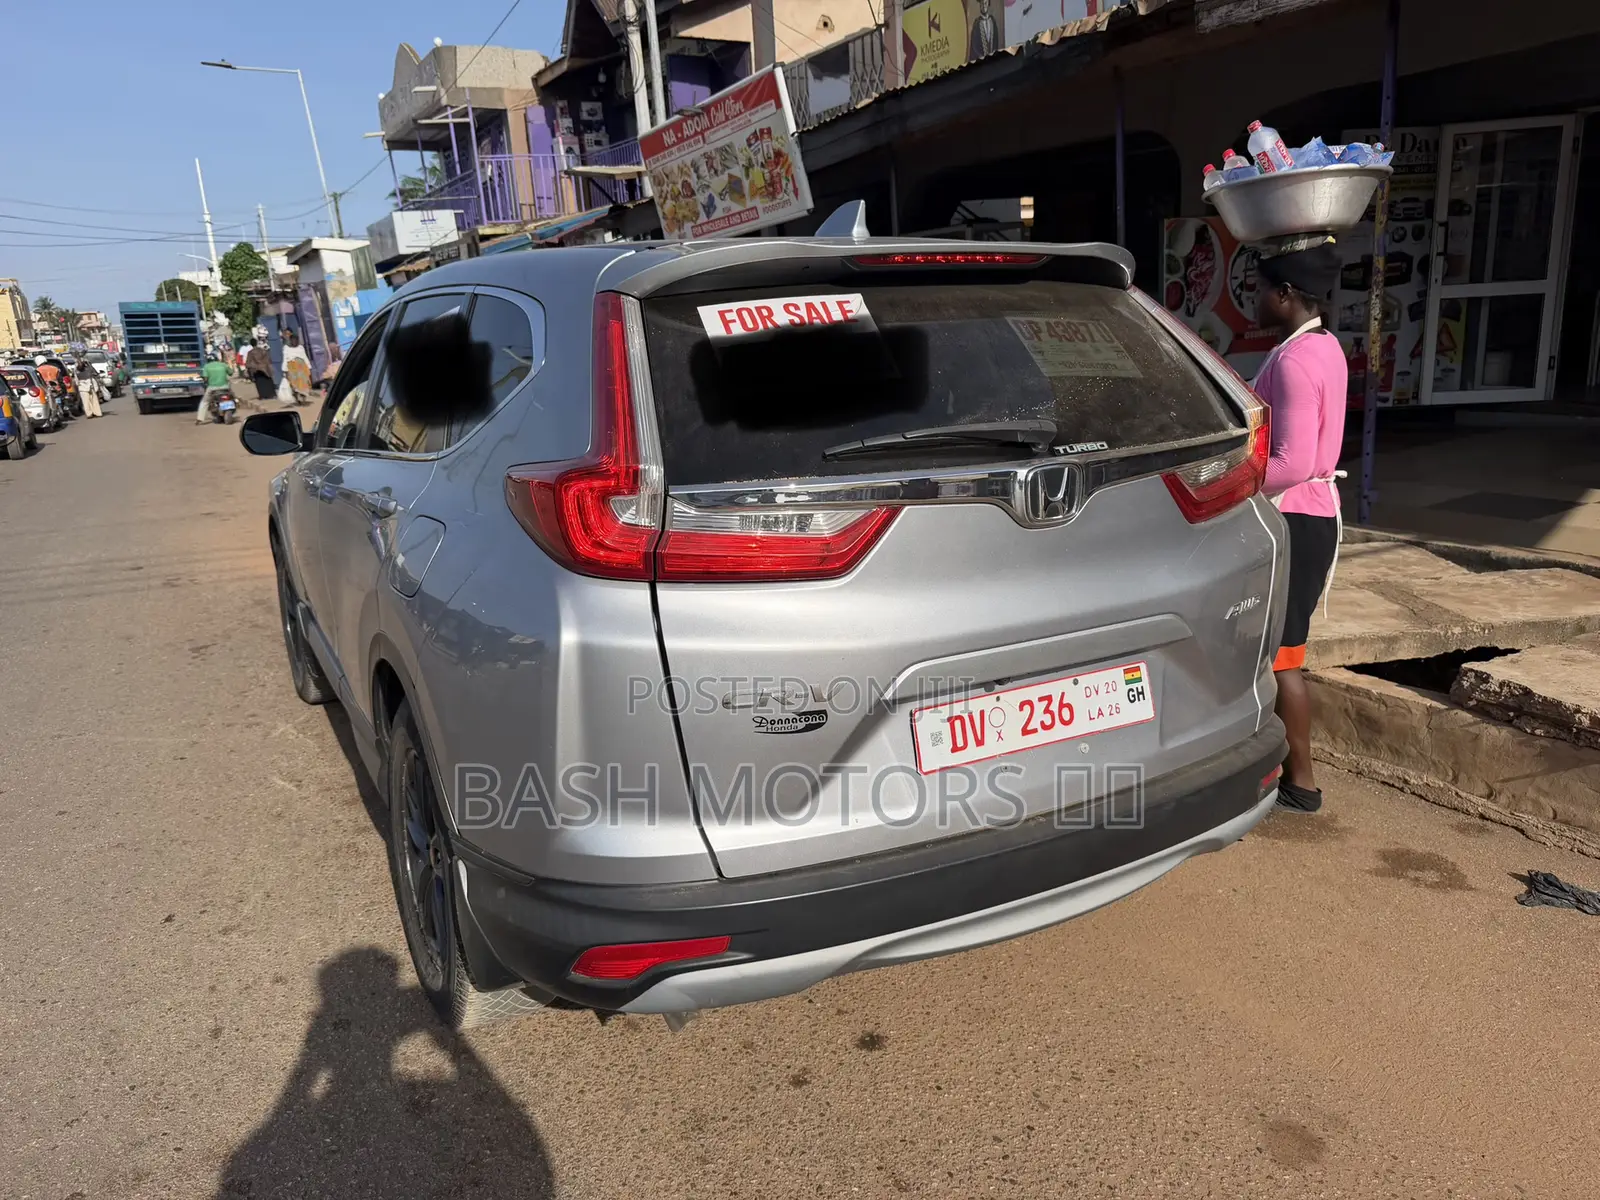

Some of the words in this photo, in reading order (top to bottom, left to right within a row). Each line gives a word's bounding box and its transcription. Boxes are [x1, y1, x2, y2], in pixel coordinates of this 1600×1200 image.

[920, 35, 950, 57] KMEDIA
[662, 127, 677, 147] NA
[682, 112, 711, 138] ADOM
[711, 101, 725, 126] Cold
[725, 95, 745, 119] Store
[729, 213, 742, 226] AND
[717, 306, 780, 335] FOR
[783, 300, 859, 328] SALE
[1053, 441, 1108, 455] TURBO
[1084, 684, 1100, 699] DV
[1104, 680, 1118, 693] 20
[1127, 685, 1146, 704] GH
[752, 714, 825, 728] Donnacona
[1088, 706, 1105, 721] LA
[1108, 702, 1121, 716] 26
[766, 724, 799, 732] Honda
[947, 709, 986, 754] DV
[1018, 691, 1075, 737] 236
